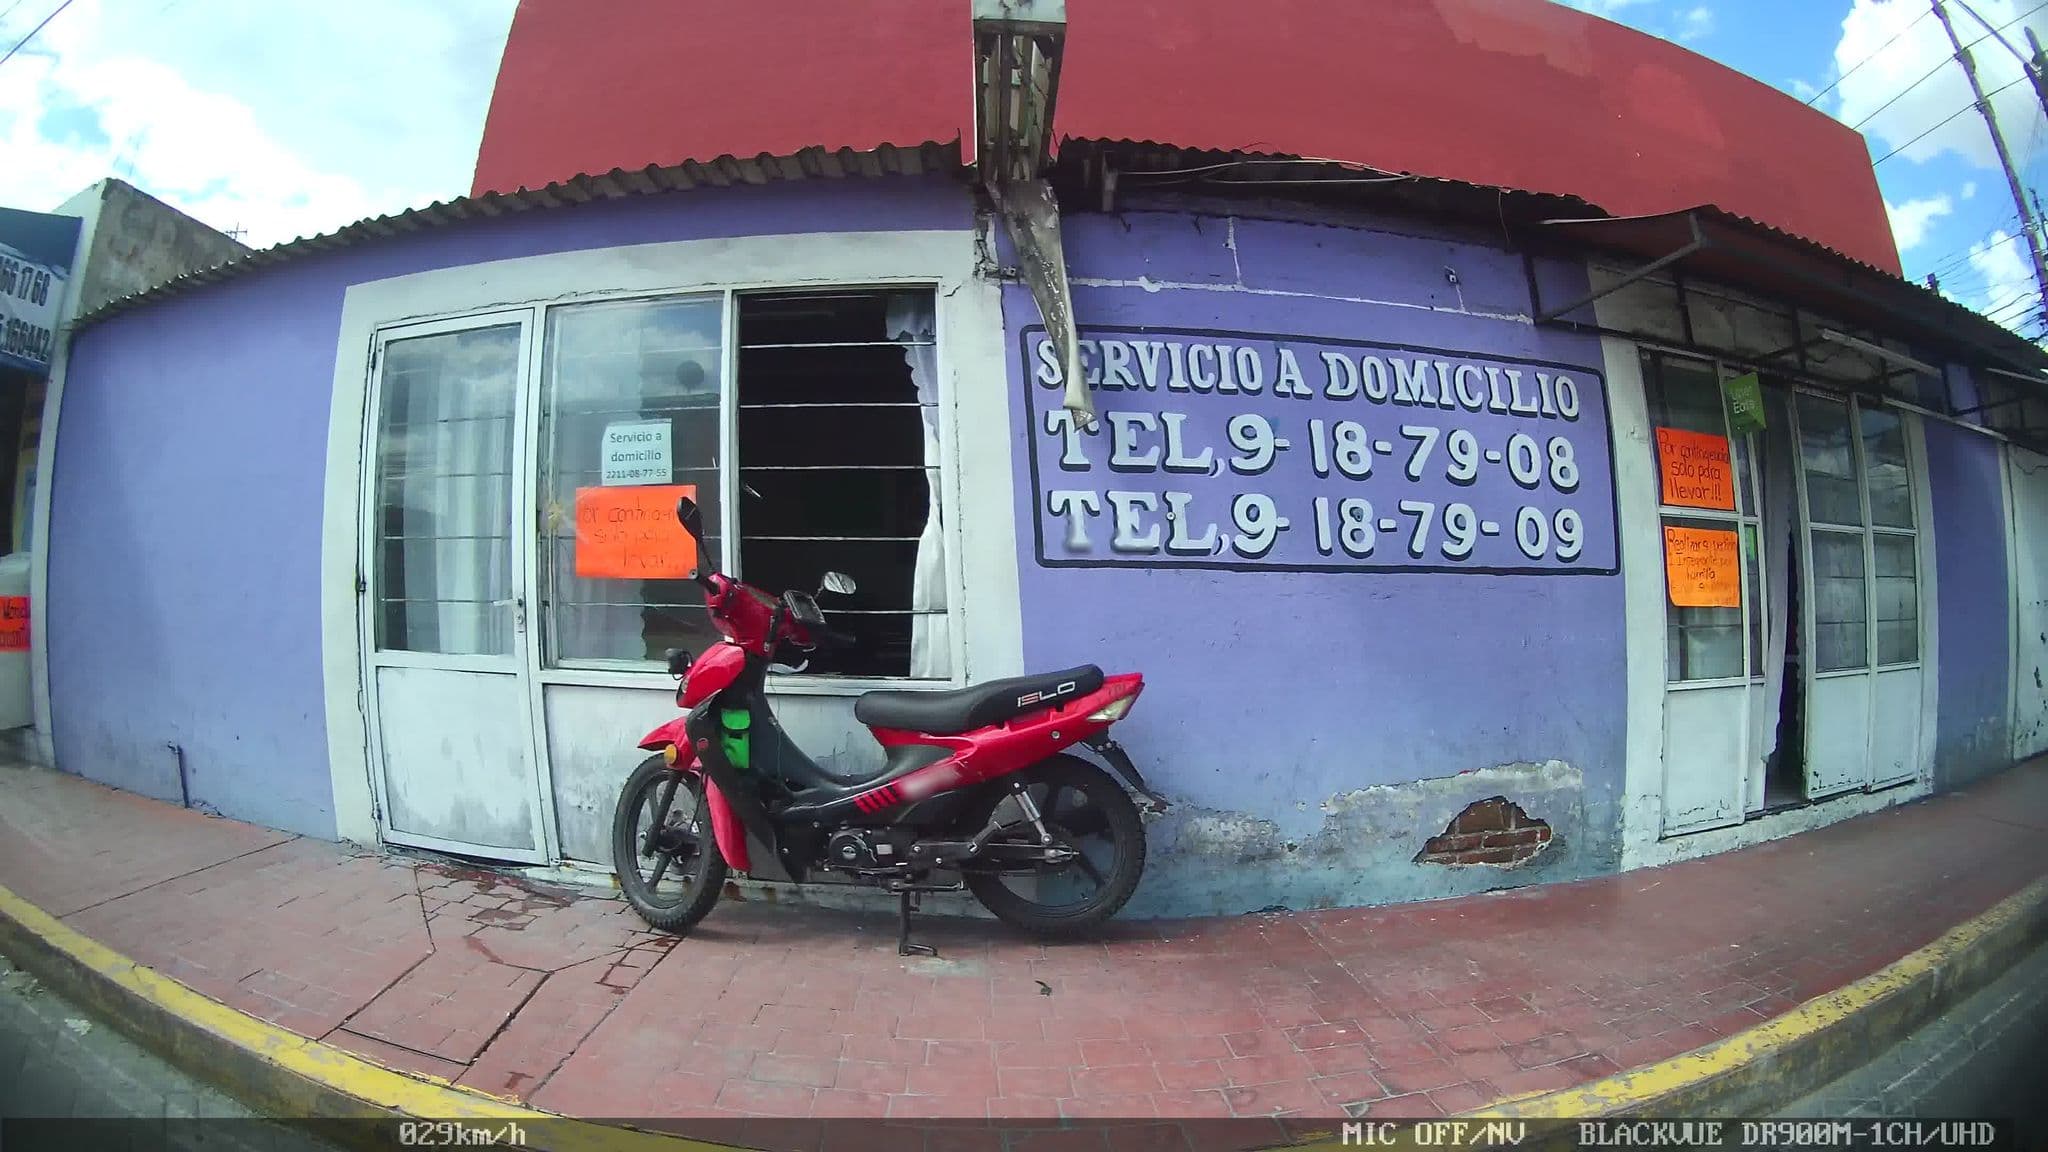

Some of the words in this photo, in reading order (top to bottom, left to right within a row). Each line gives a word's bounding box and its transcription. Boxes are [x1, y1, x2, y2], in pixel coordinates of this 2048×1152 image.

[31, 270, 51, 306] 68
[1037, 339, 1263, 393] SERVICIO
[1275, 341, 1313, 398] A
[1321, 350, 1580, 420] DOMICILIO
[610, 432, 653, 443] Servicio
[655, 432, 662, 441] a
[611, 450, 662, 462] domicilio
[1671, 458, 1694, 478] solo
